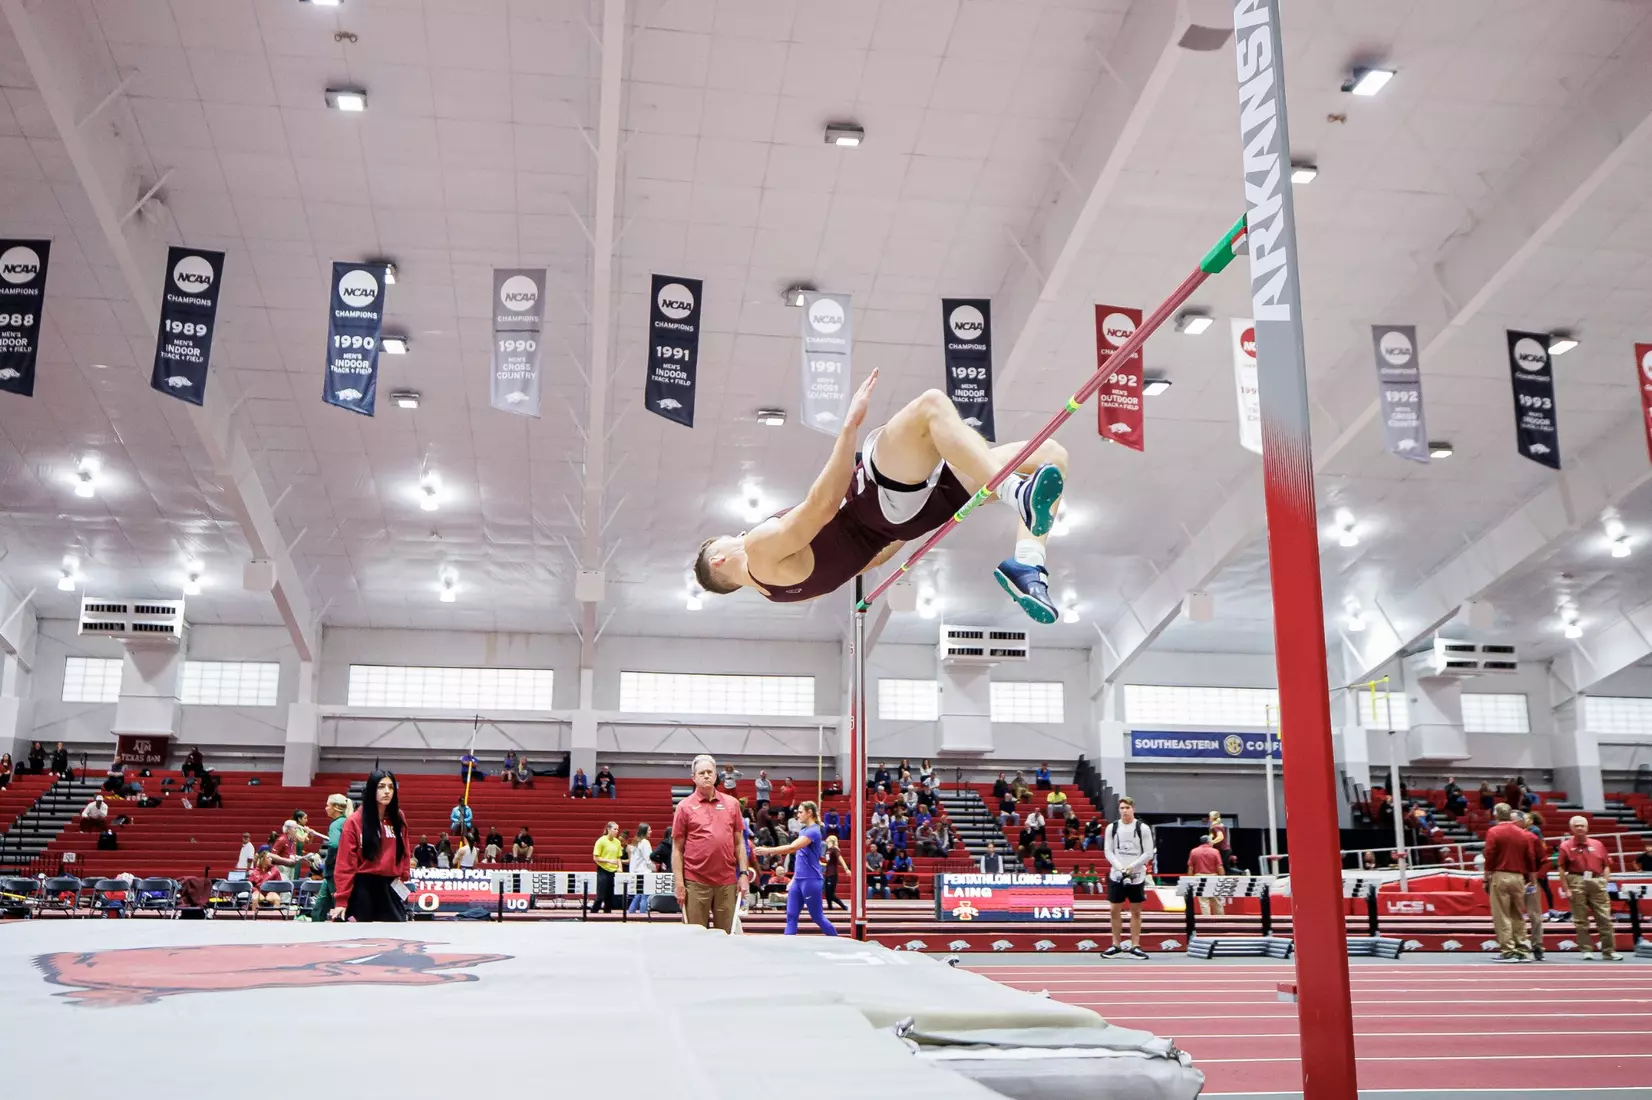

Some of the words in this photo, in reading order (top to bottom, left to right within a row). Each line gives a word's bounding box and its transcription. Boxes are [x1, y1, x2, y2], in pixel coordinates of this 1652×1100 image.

[3, 264, 37, 274] NCAA
[177, 272, 211, 285] NCAA
[343, 288, 376, 298] NCAA
[504, 292, 536, 302] NCAA
[167, 294, 211, 306] CHAMPIONS
[661, 299, 692, 311] NCAA
[0, 313, 34, 326] 988
[335, 310, 377, 319] CHAMPIONS
[812, 315, 843, 324] NCAA
[165, 319, 207, 337] 1989
[654, 321, 694, 332] CHAMPIONS
[954, 321, 983, 331] NCAA
[334, 335, 375, 350] 1990
[499, 340, 537, 352] 1990
[166, 344, 201, 356] INDOOR
[656, 346, 690, 361] 1991
[161, 351, 180, 360] TRACK
[186, 355, 204, 363] FIELD
[1518, 352, 1545, 363] NCAA
[330, 365, 350, 373] TRACK
[335, 359, 369, 368] INDOOR
[502, 363, 531, 371] CROSS
[810, 361, 842, 374] 1991
[496, 371, 537, 380] COUNTRY
[656, 368, 687, 379] INDOOR
[951, 367, 987, 379] 1992
[651, 374, 669, 383] TRACK
[675, 378, 691, 386] FIELD
[1105, 372, 1138, 387] 992
[955, 389, 985, 397] INDOOR
[1240, 386, 1257, 395] 199
[1100, 394, 1138, 404] OUTDOOR
[1385, 391, 1419, 402] 1992
[1519, 394, 1552, 409] 1993
[1135, 739, 1220, 750] SOUTHEASTERN
[122, 754, 145, 762] TEXAS
[412, 879, 492, 891] FITZSIMMO
[943, 885, 992, 898] LAING
[507, 899, 528, 910] UO
[1387, 901, 1424, 914] UCS
[1033, 907, 1072, 919] IAST
